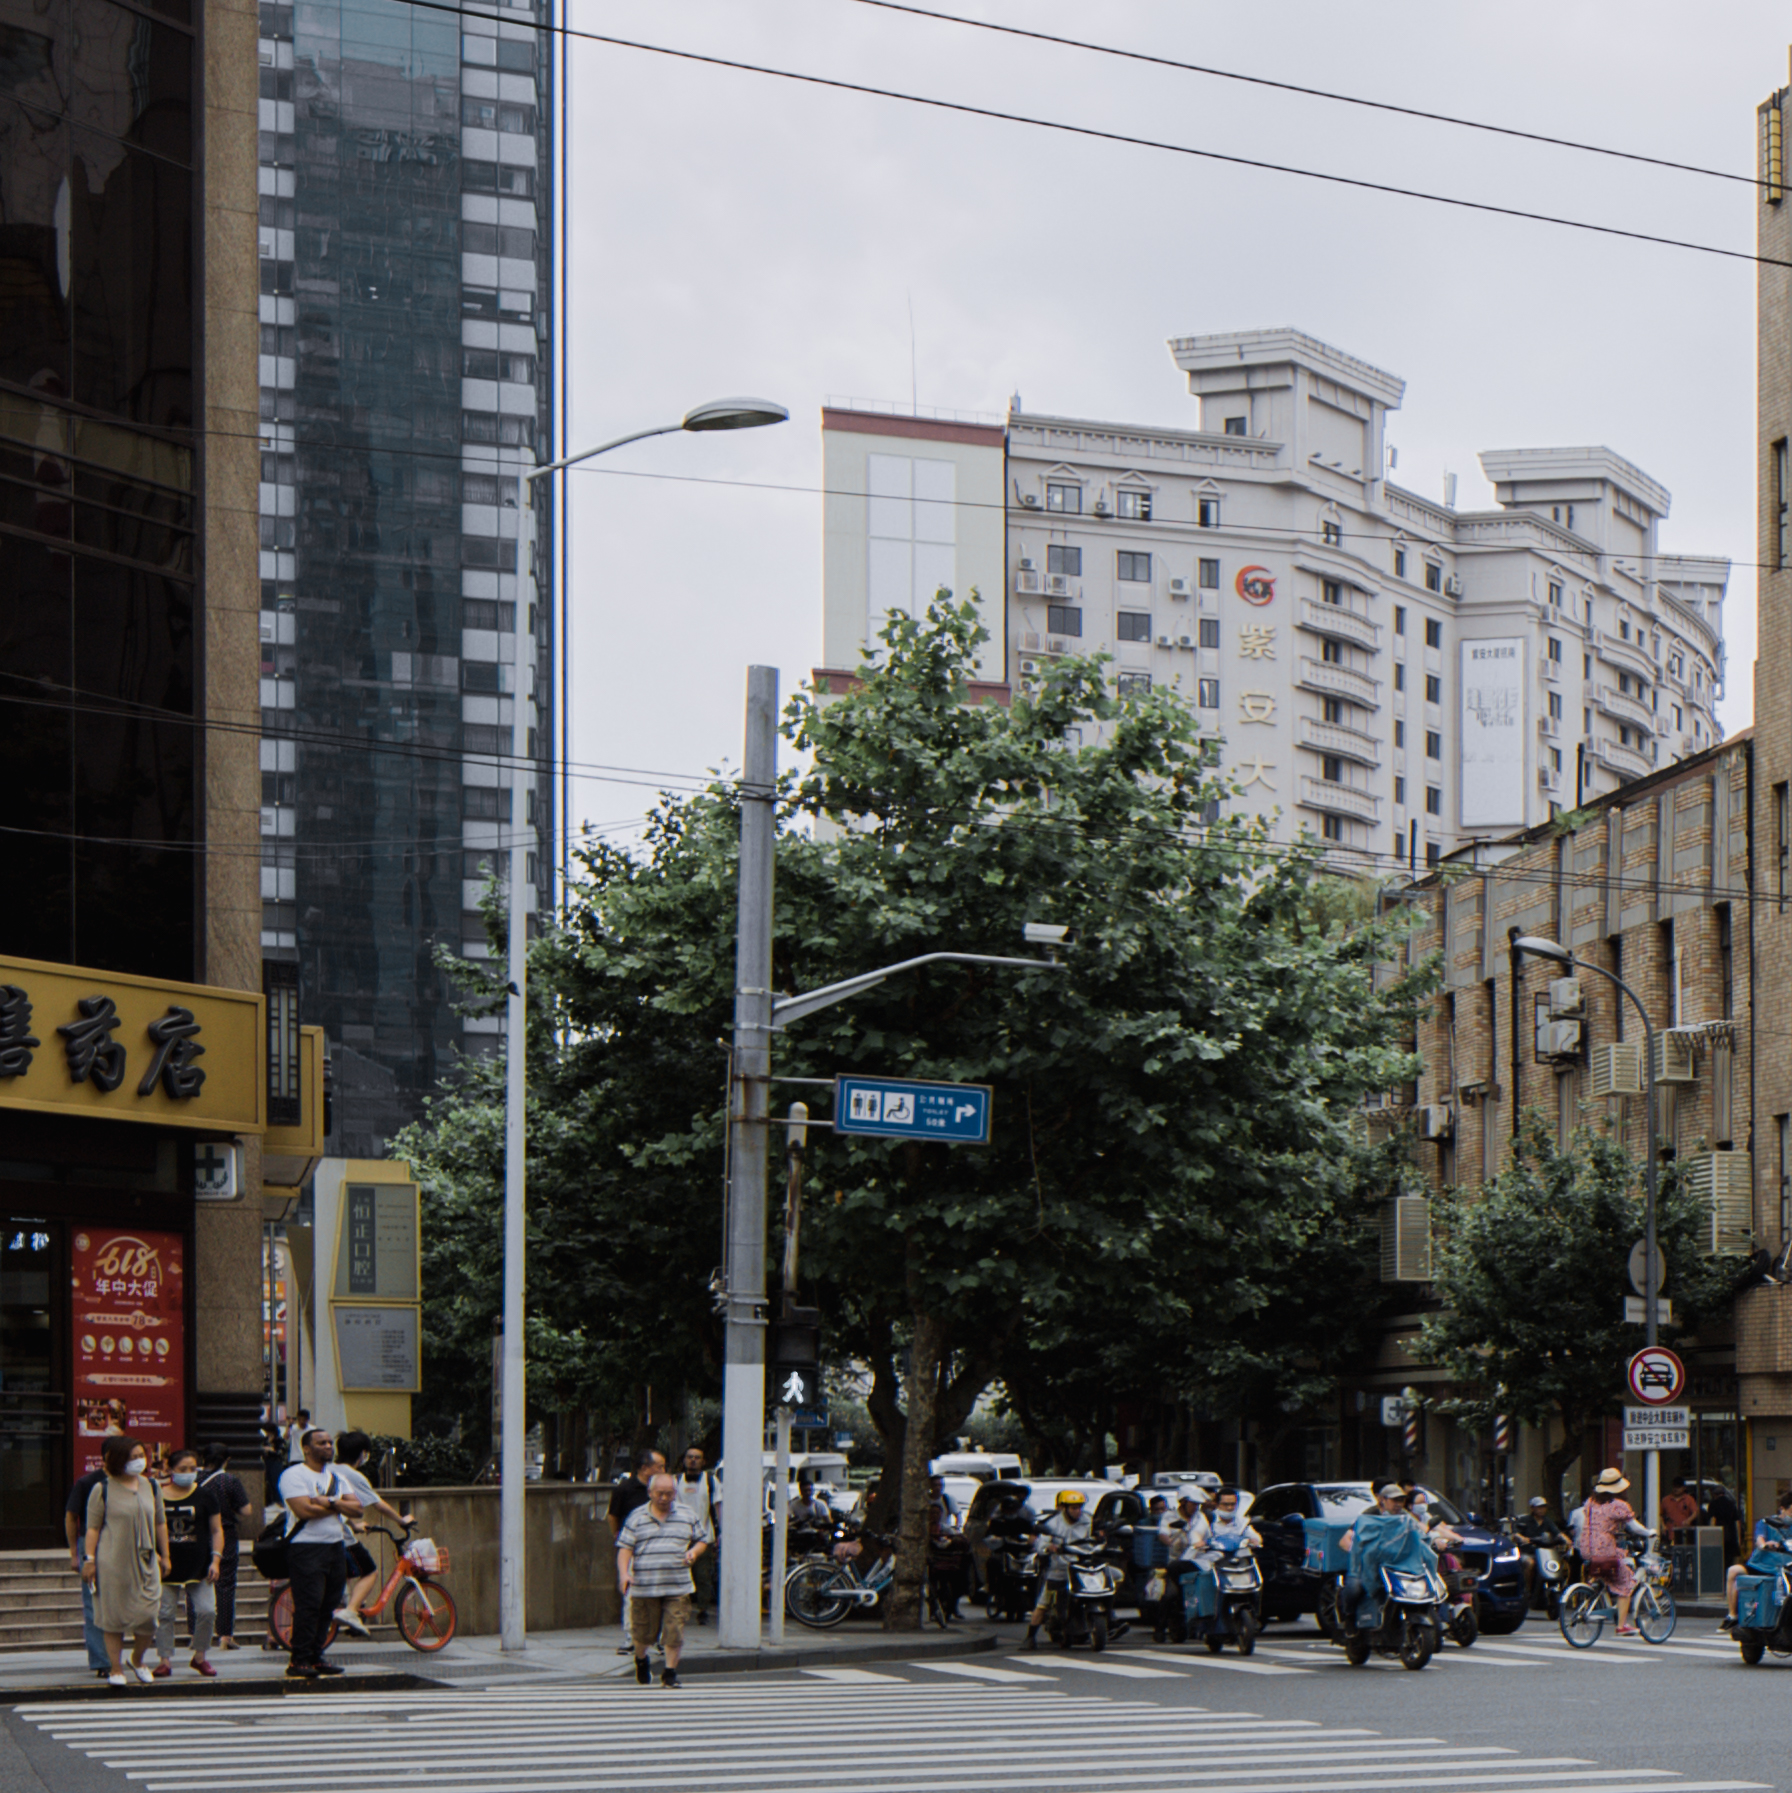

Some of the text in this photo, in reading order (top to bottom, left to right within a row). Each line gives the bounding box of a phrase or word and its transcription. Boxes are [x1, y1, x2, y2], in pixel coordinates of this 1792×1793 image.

[1239, 622, 1277, 856] 紫安大
[95, 1247, 159, 1277] 618
[96, 1278, 158, 1297] 年中大促
